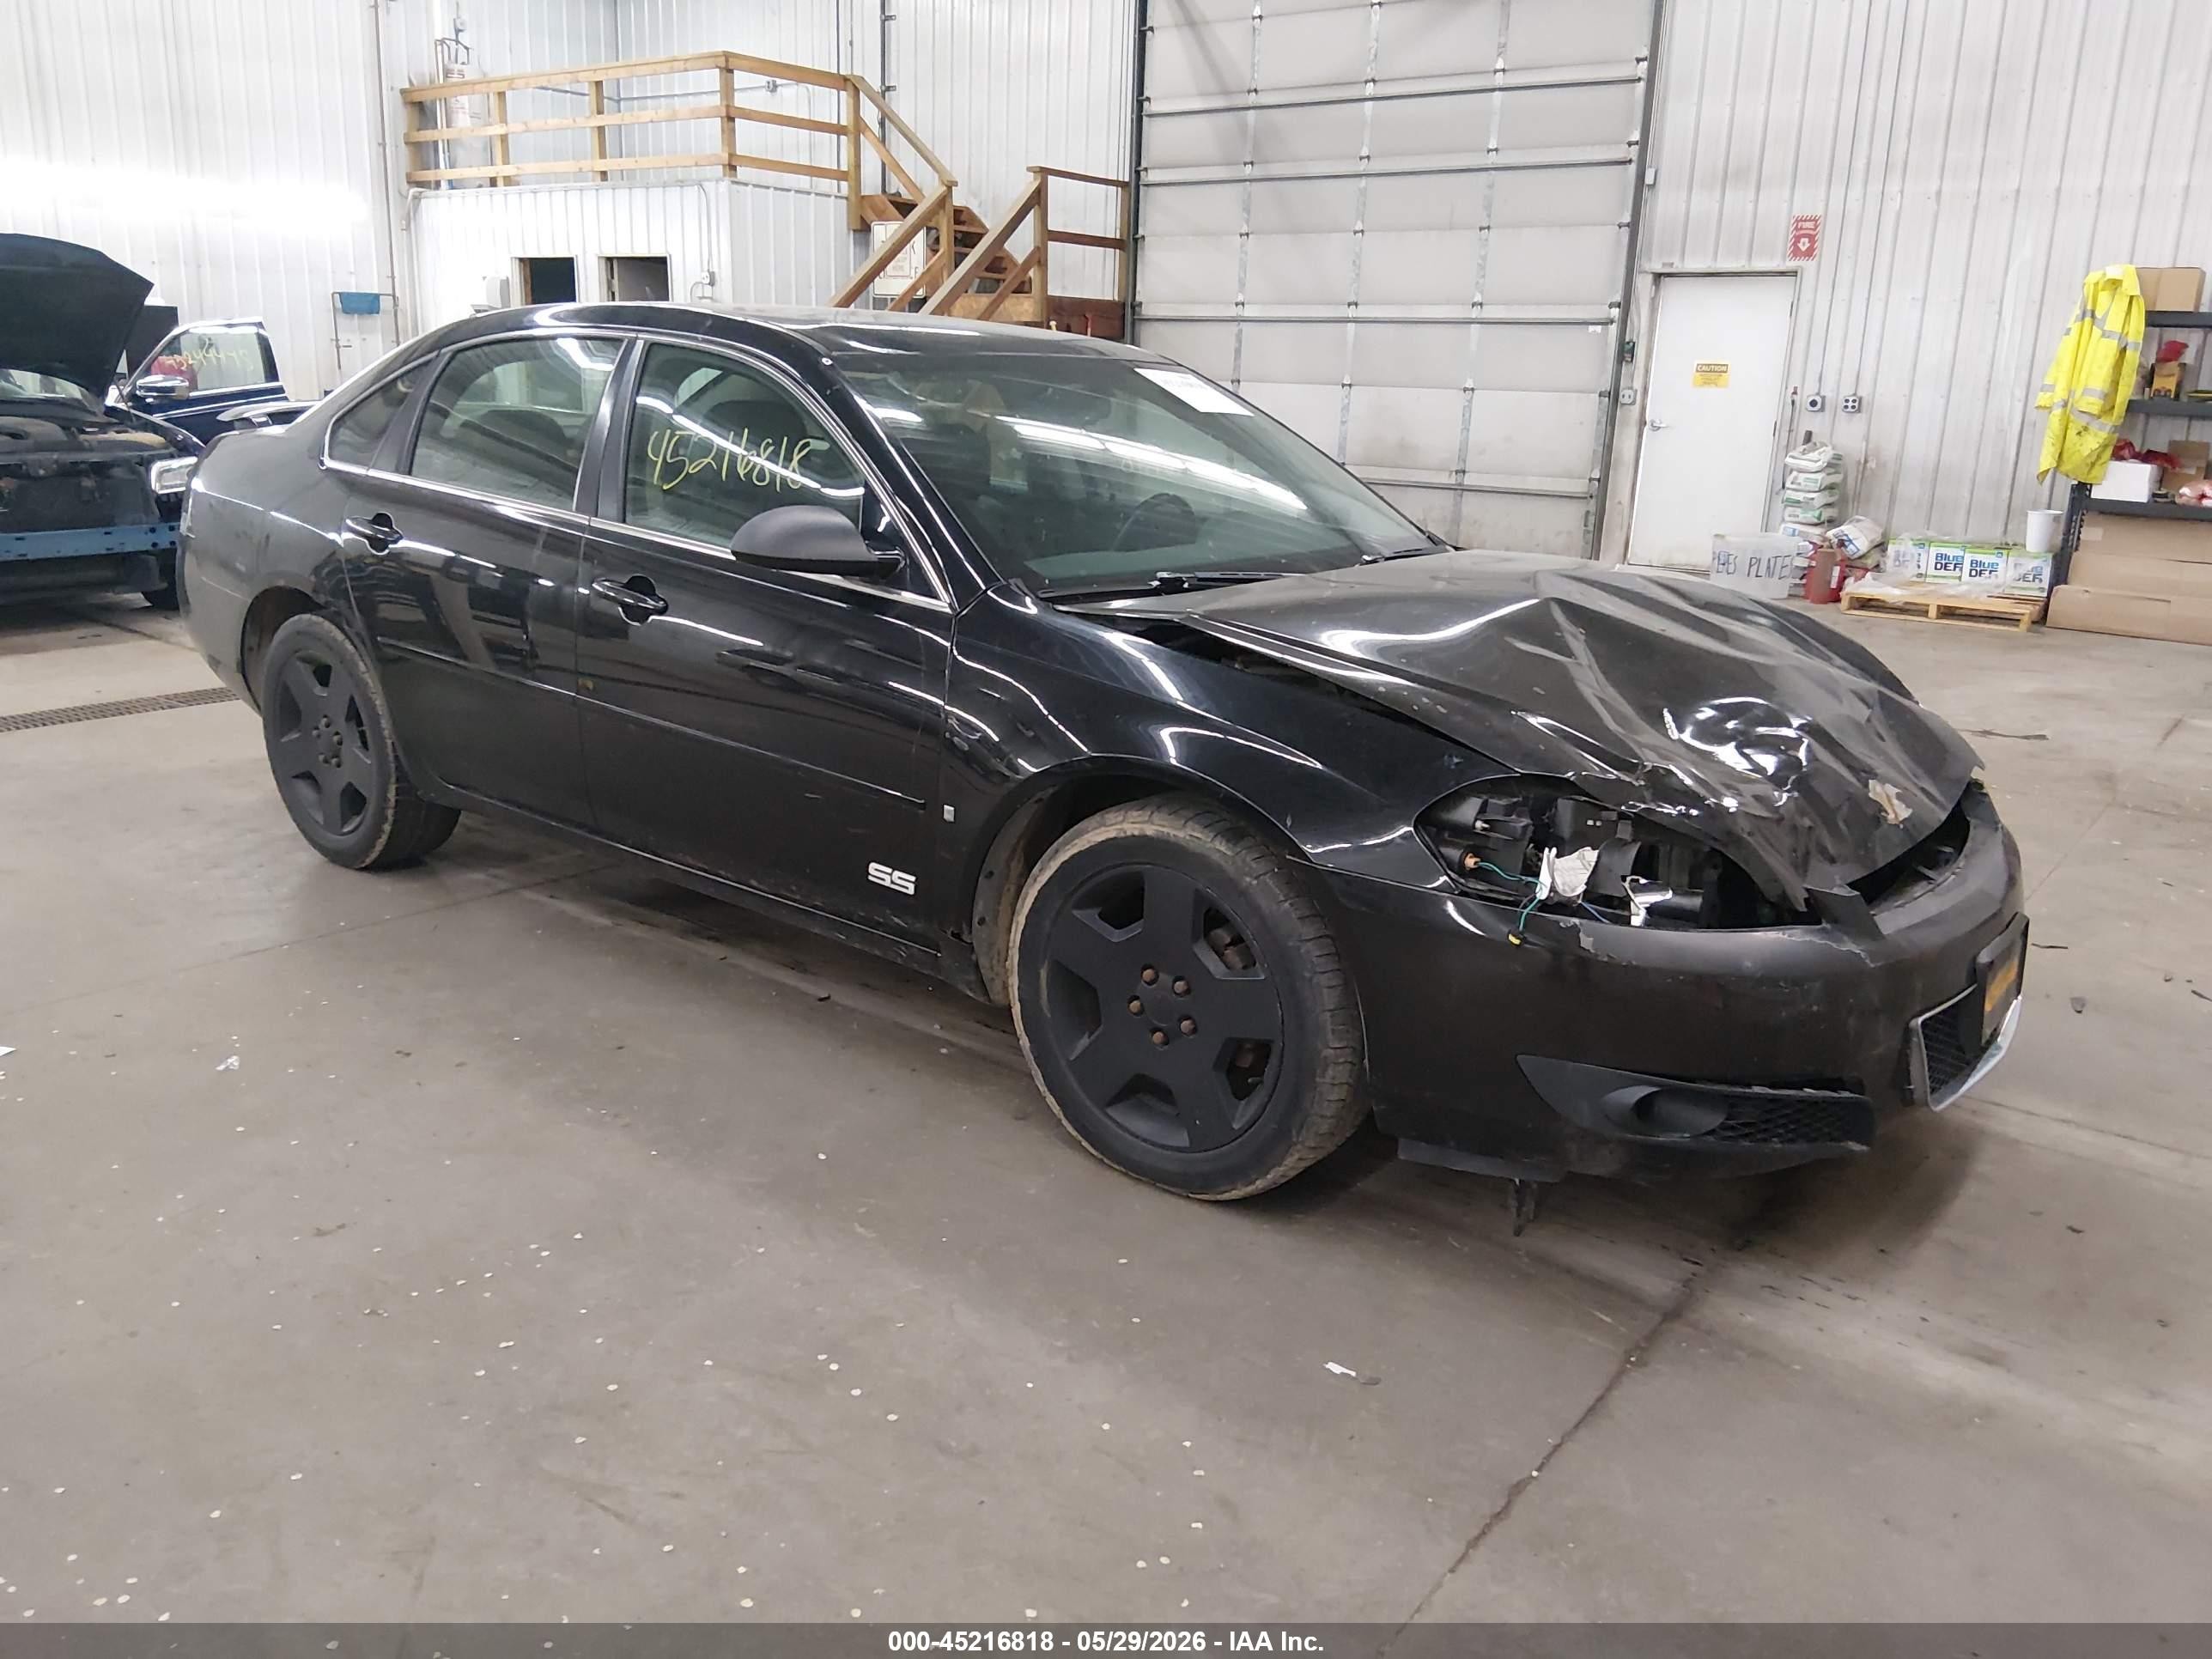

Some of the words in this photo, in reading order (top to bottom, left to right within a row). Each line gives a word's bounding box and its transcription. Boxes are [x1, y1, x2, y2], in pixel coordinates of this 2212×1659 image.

[647, 428, 812, 493] 45216818
[1934, 562, 1964, 572] DEF
[1970, 559, 1999, 569] Blue
[867, 861, 916, 895] SS
